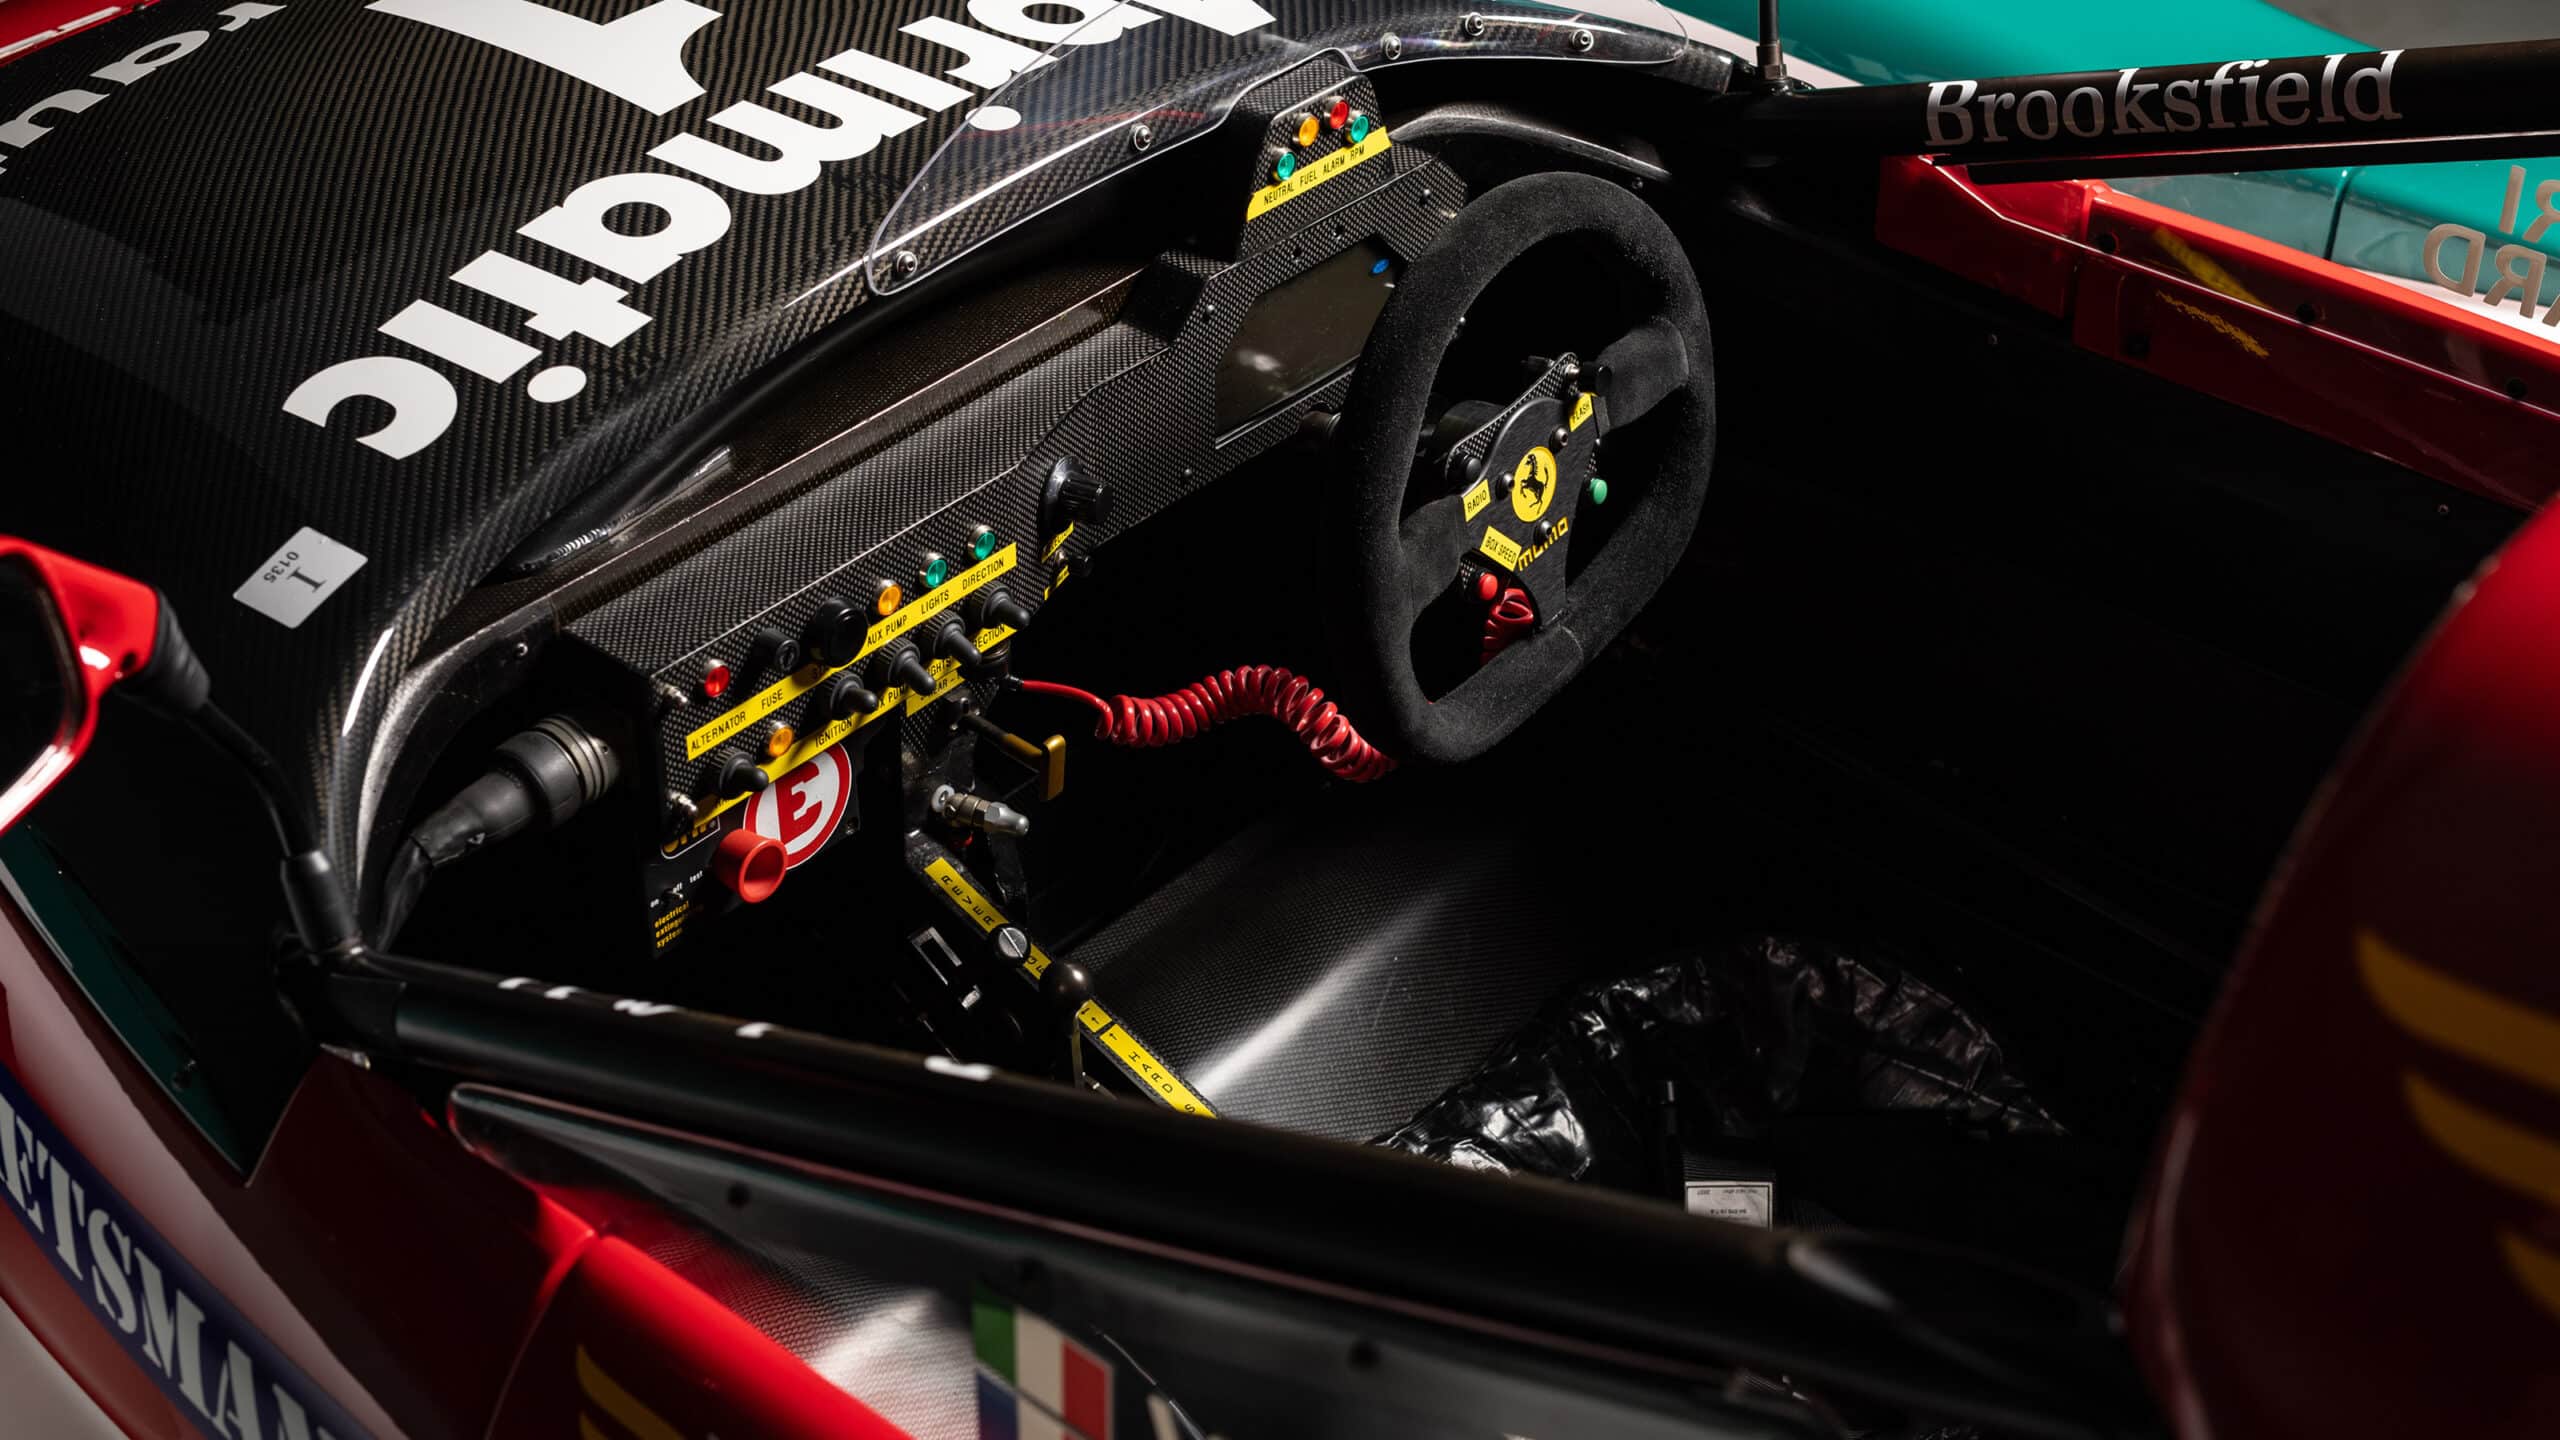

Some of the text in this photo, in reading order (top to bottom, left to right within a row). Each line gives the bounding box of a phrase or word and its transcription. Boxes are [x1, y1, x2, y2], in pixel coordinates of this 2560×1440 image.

[1925, 50, 2405, 147] Brooksfield
[1263, 144, 1366, 206] NEUTRAL FUEL ALARM RPM
[1571, 402, 1590, 423] FLASH
[1466, 488, 1488, 513] RADIO
[1484, 535, 1517, 565] BOX SPEED
[263, 551, 299, 584] 0135
[690, 558, 1005, 751] ALTERNATOR FUSE AUX PUMP LIGHTS DIRECTION
[814, 717, 853, 749] IGNITION
[774, 761, 823, 846] E
[654, 901, 690, 929] electrical
[1128, 1050, 1174, 1094] HARD
